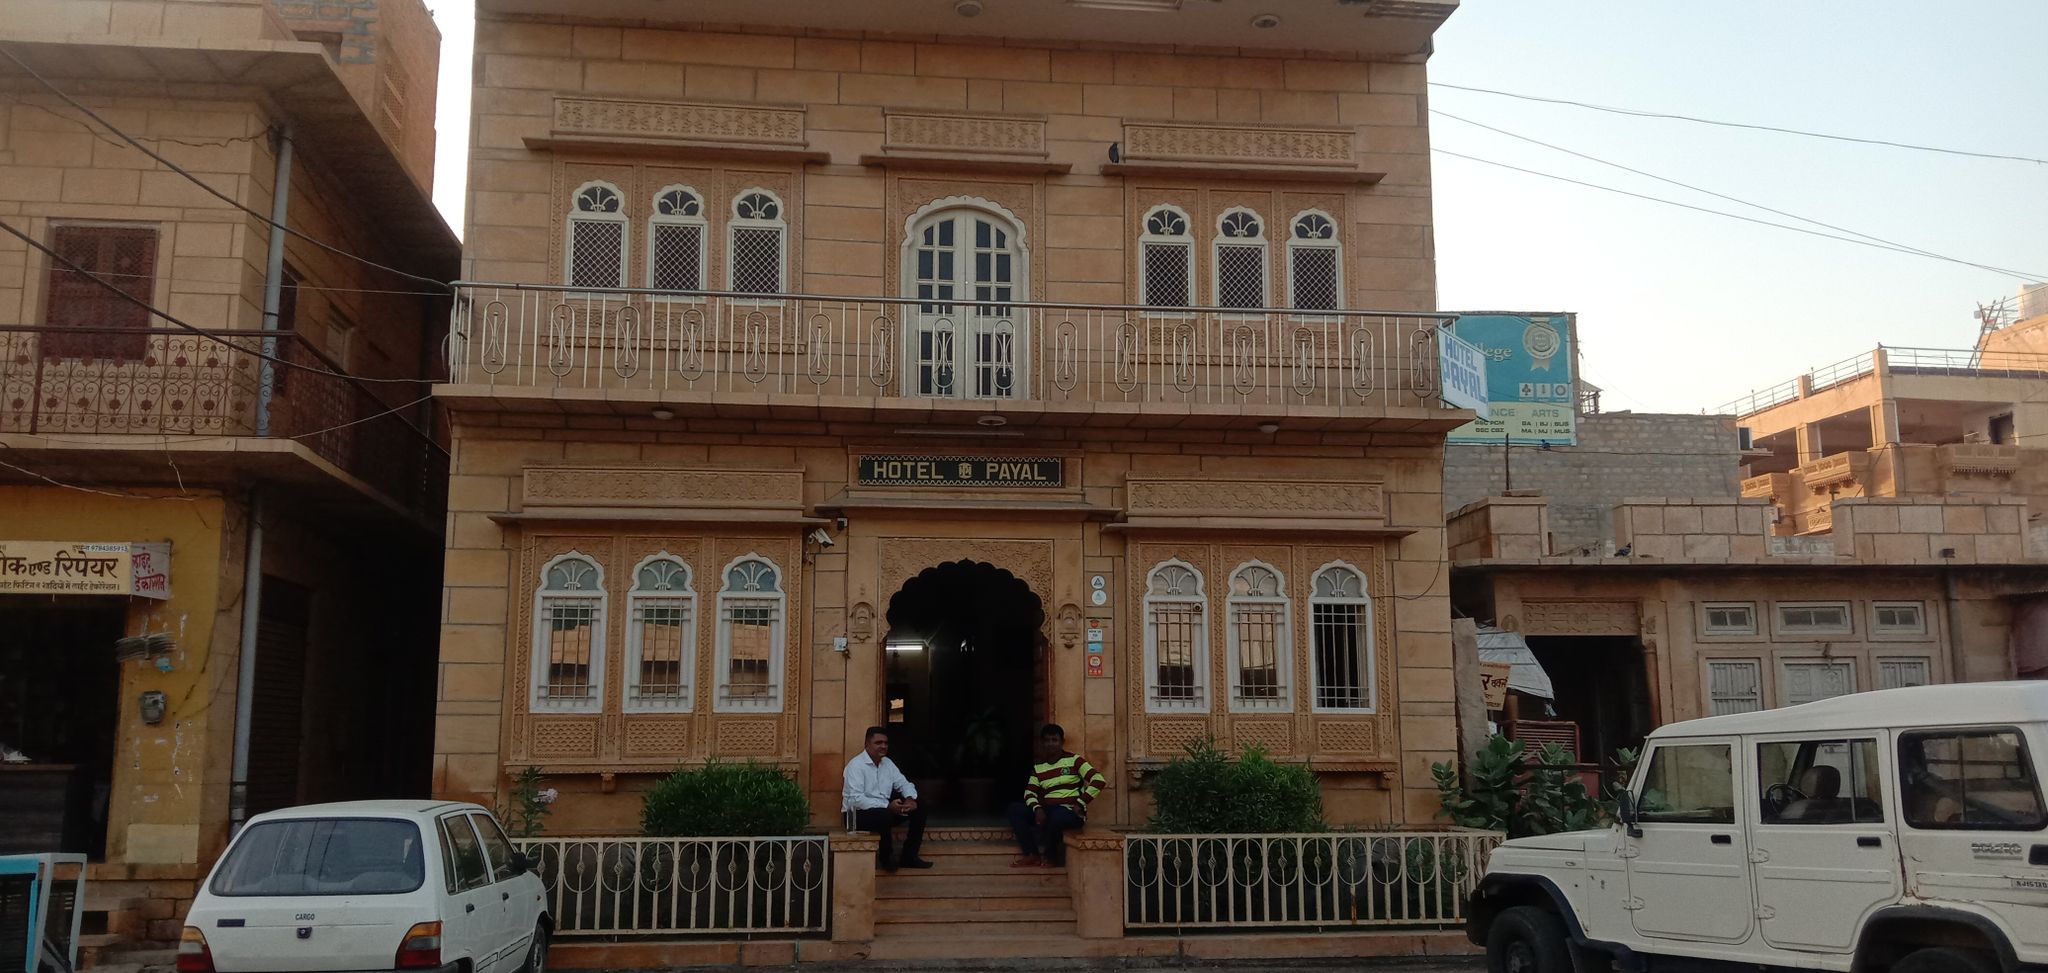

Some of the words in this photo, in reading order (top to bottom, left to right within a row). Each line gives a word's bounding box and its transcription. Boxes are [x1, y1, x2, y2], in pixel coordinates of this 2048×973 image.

[1445, 335, 1478, 372] HOTEL
[1442, 357, 1487, 404] PAYAL
[1489, 407, 1515, 417] NCE
[1532, 408, 1559, 418] ARTS
[873, 461, 944, 480] HOTEL
[986, 462, 1047, 481] PAYAL
[54, 550, 119, 579] रिपेयर
[295, 912, 315, 921] CARGO
